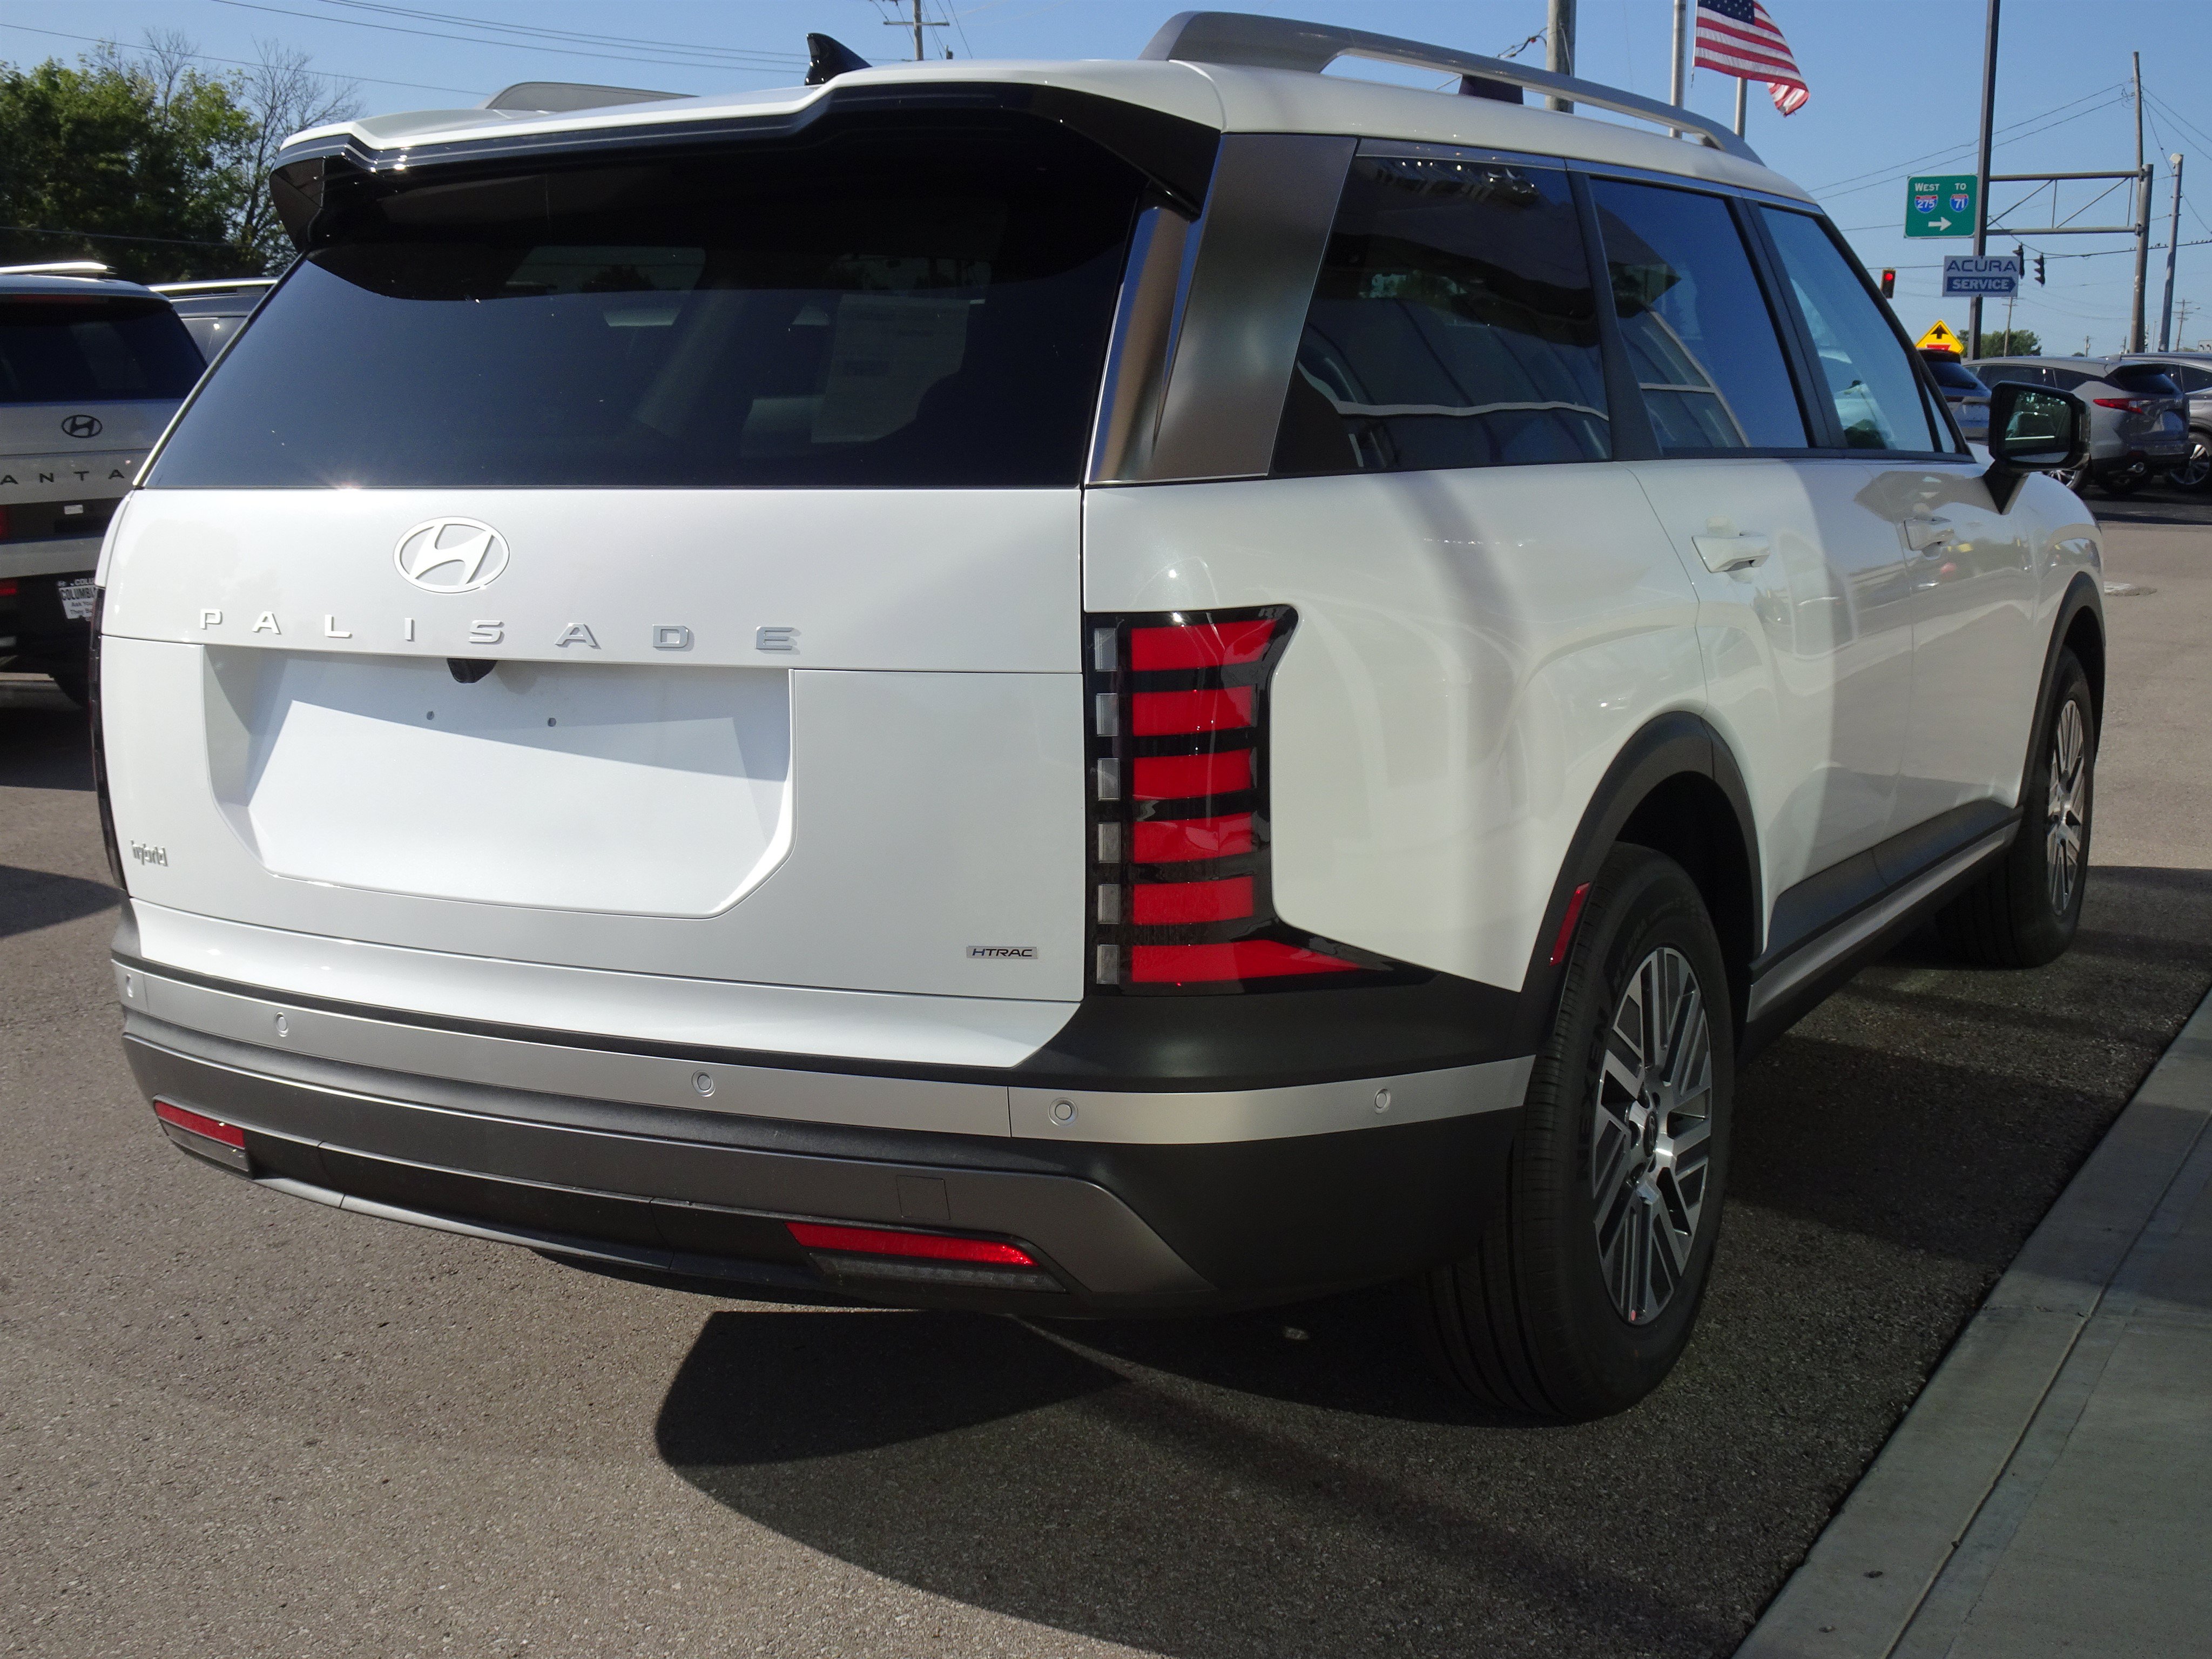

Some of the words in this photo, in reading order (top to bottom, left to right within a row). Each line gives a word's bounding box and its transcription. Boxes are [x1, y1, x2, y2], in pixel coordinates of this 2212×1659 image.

[1914, 183, 1940, 191] WEST
[1917, 199, 1935, 209] 275
[1954, 199, 1965, 209] 71
[1946, 260, 2018, 272] ACURA
[1952, 279, 2009, 289] SERVICE
[0, 469, 125, 485] ANTA
[199, 608, 795, 650] PALISADE
[972, 948, 1033, 957] HTRAC
[1576, 1006, 1609, 1183] NEXEN
